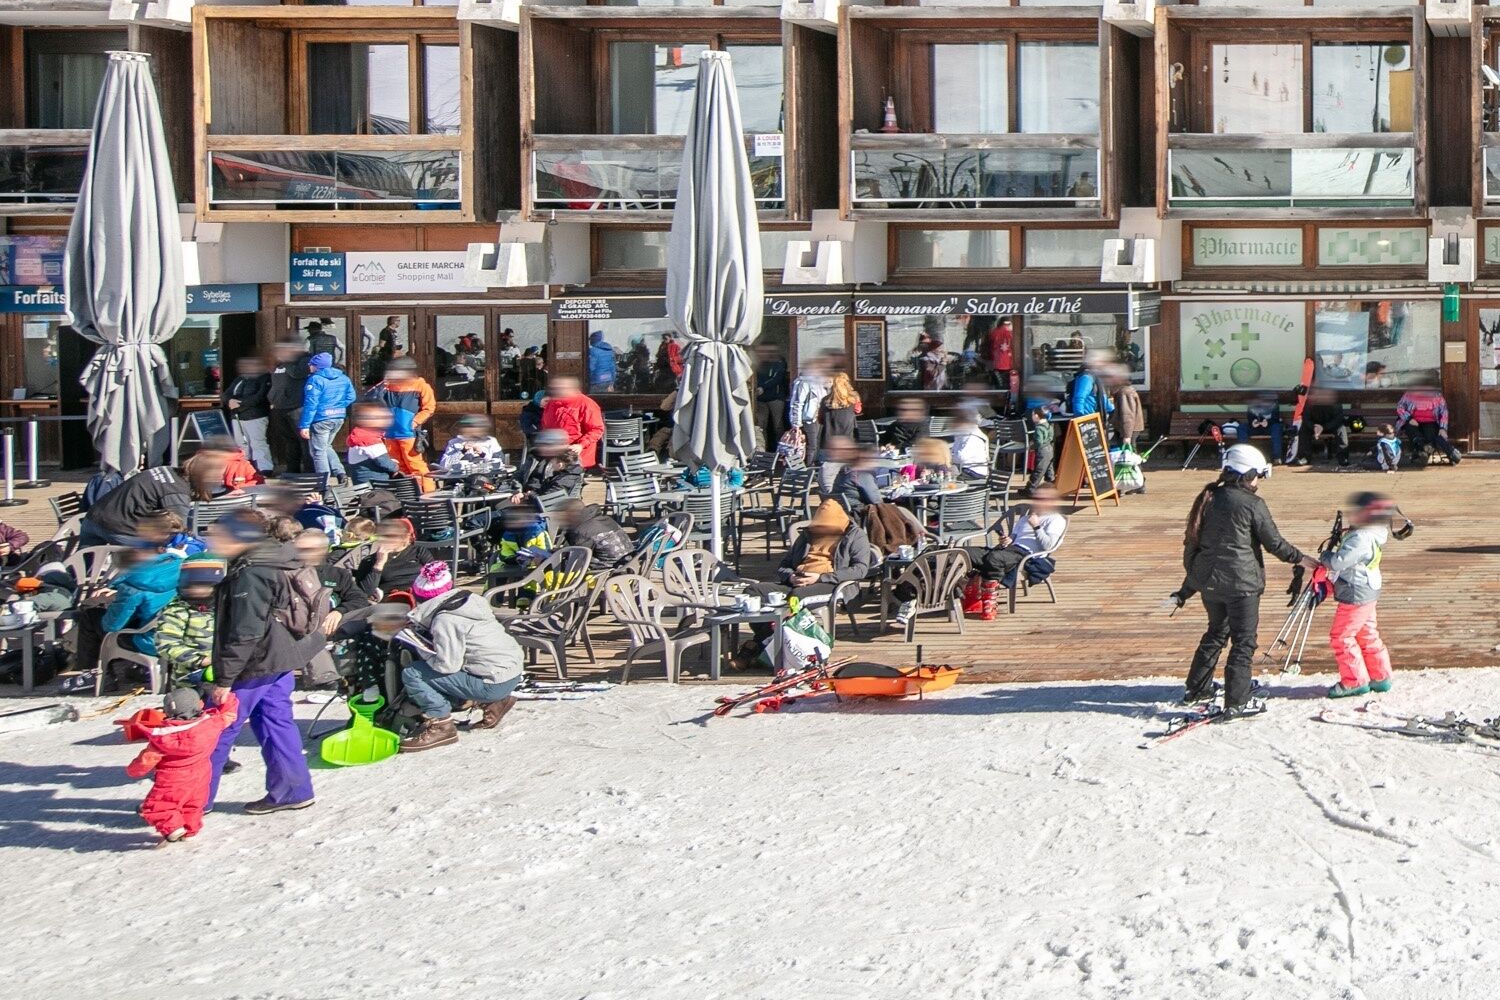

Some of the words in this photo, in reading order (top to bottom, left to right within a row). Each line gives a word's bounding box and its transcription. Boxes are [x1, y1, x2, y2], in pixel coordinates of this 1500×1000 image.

[1199, 236, 1298, 259] Pharmacie
[293, 257, 318, 266] Forfait
[319, 257, 329, 266] de
[329, 257, 342, 266] ski
[397, 261, 430, 270] GALERIE
[431, 261, 465, 270] MARCHA
[302, 269, 314, 278] Ski
[315, 269, 333, 278] Pass
[358, 272, 386, 282] Corbier
[397, 272, 436, 282] Shopping
[436, 272, 454, 281] Mall
[14, 290, 66, 304] Forfaits
[965, 297, 1019, 314] Salon
[1023, 297, 1045, 314] de
[1047, 297, 1082, 313] Thé
[1191, 307, 1294, 335] Pharmacie
